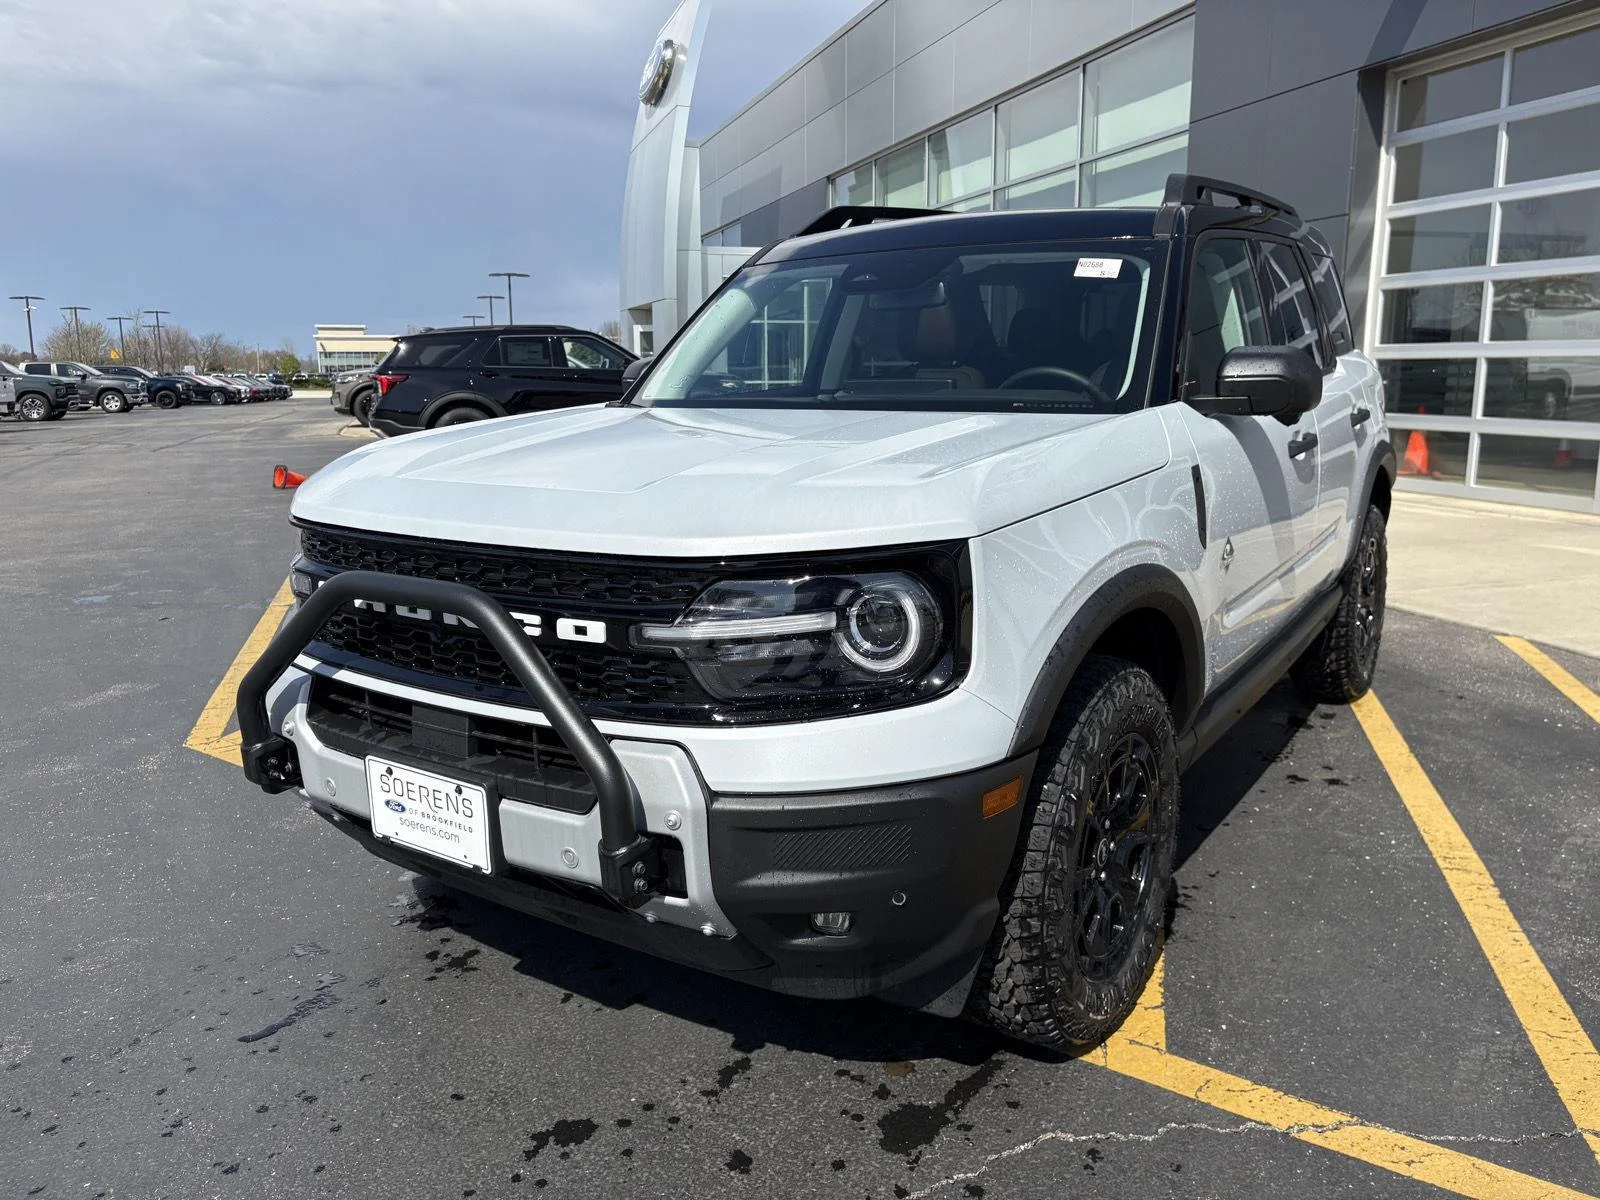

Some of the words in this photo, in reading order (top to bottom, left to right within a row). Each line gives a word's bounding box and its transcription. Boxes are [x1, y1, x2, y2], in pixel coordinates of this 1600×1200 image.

[380, 774, 474, 818] SOERENS
[399, 817, 461, 843] soerens.com
[408, 807, 418, 816] OF
[421, 811, 474, 834] BROOKFIELD
